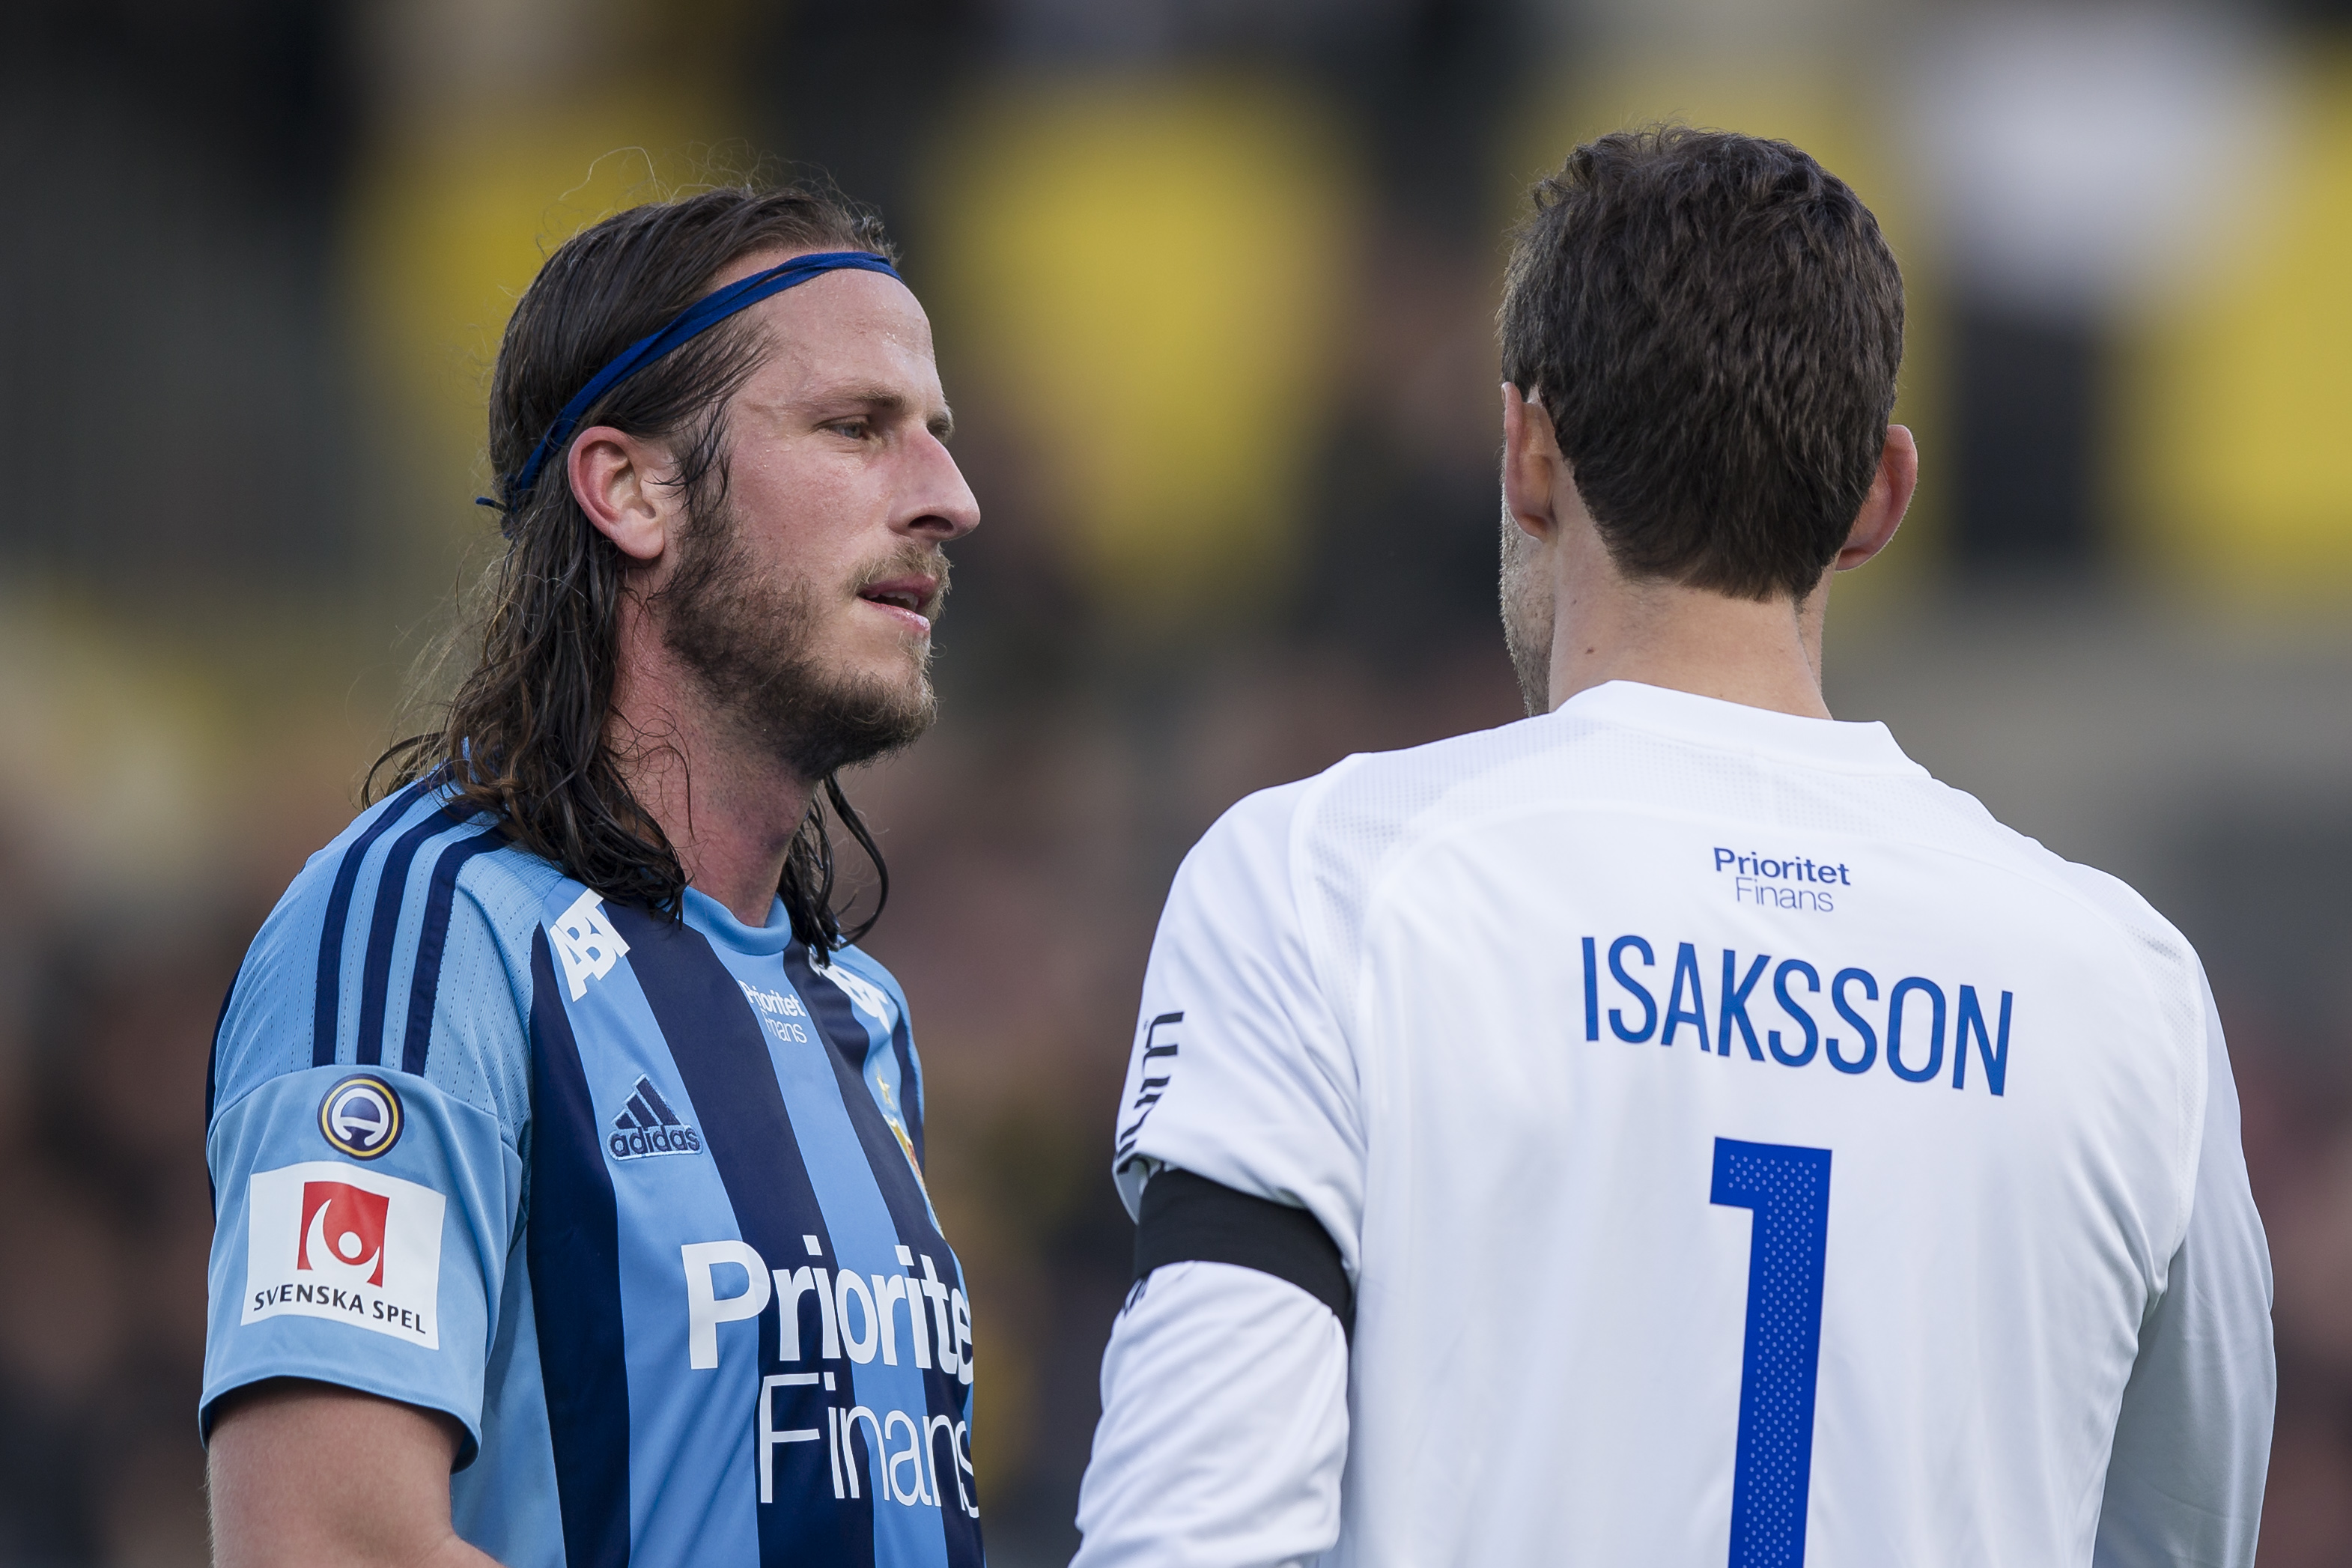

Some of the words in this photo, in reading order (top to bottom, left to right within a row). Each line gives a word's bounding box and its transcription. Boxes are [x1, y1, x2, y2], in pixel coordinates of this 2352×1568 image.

[1713, 847, 1851, 886] Prioritet
[1736, 876, 1834, 913] Finans
[1581, 935, 2014, 1097] ISAKSSON
[610, 1124, 700, 1158] adidas
[253, 1283, 364, 1314] SVENSKA
[372, 1300, 426, 1334] SPEL
[681, 1235, 973, 1385] Priorite
[1710, 1136, 1832, 1568] 1
[759, 1372, 979, 1519] Finans
